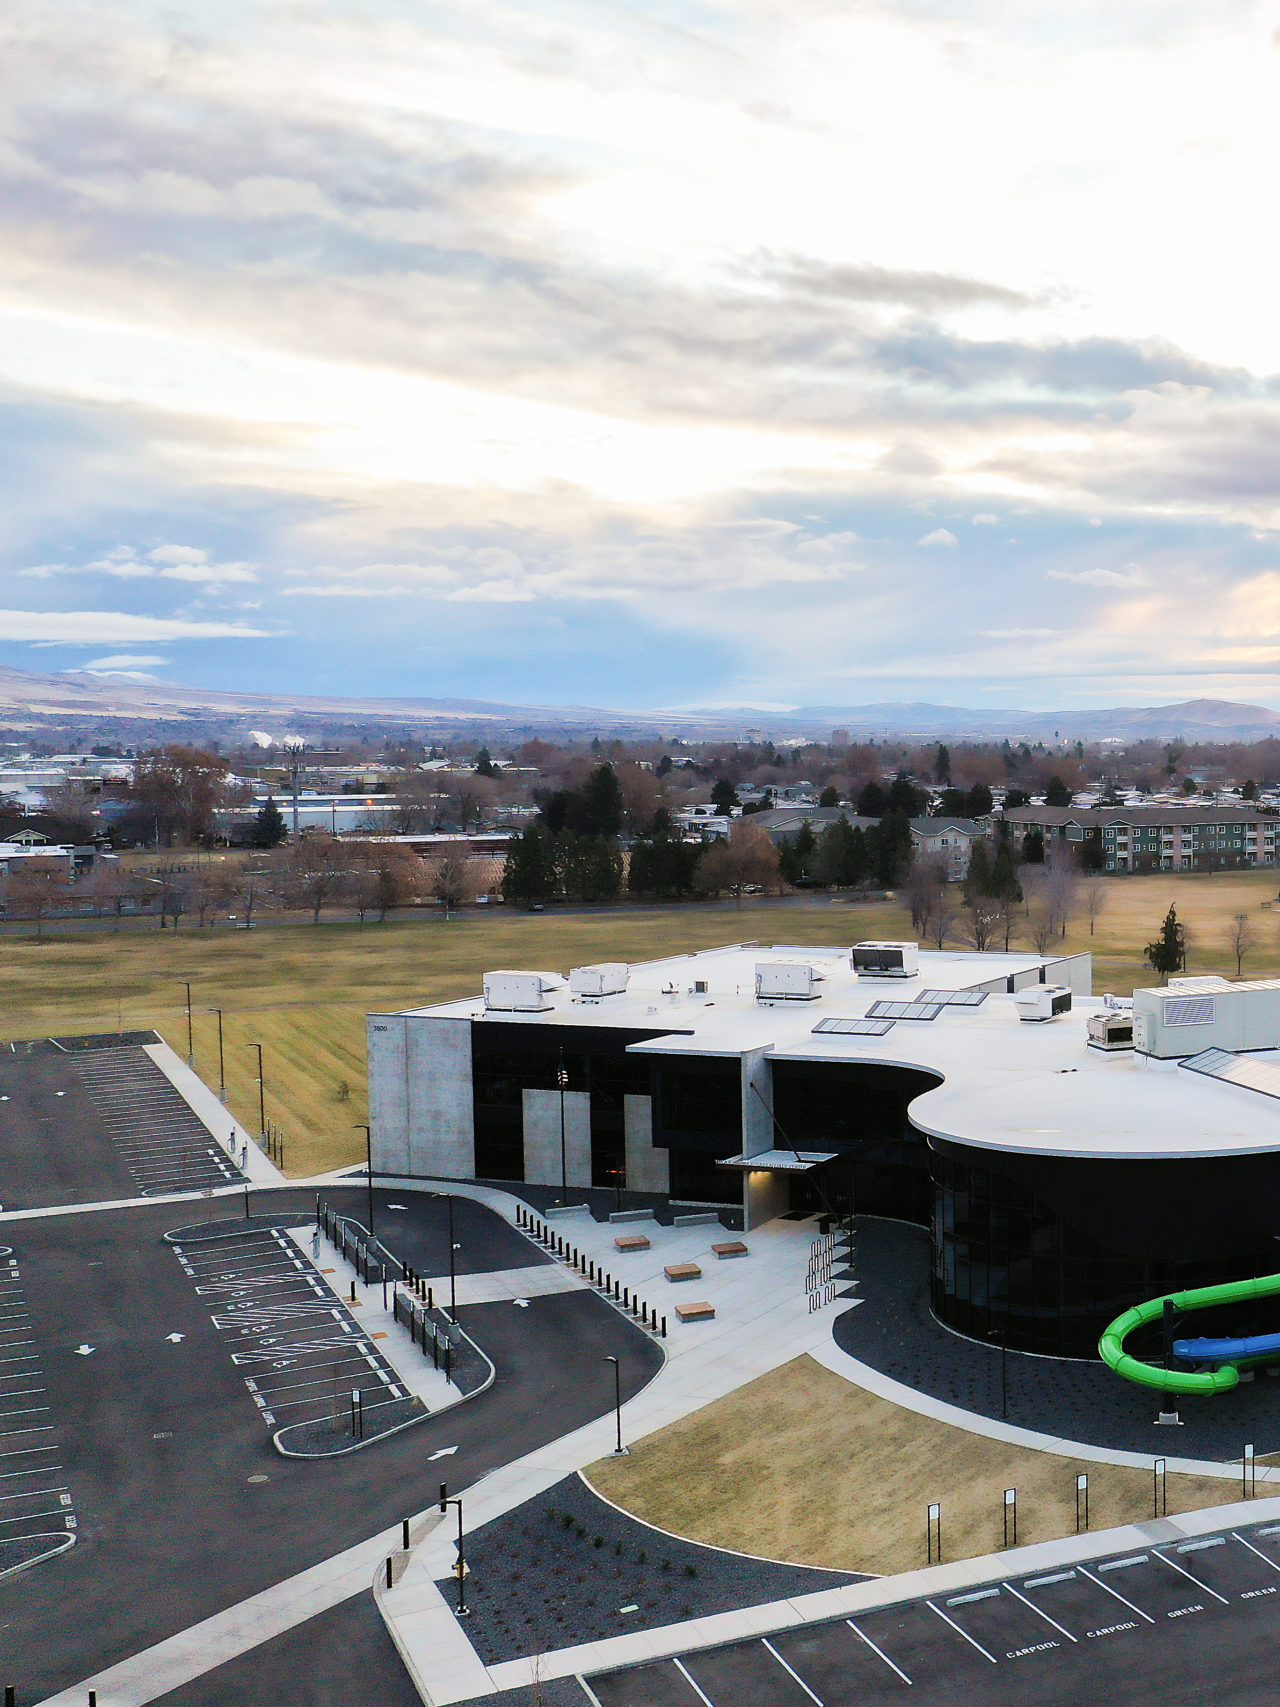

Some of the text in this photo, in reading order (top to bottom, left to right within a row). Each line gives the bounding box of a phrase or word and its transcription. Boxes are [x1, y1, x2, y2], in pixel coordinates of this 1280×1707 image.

[1240, 1586, 1278, 1599] GREEN
[1167, 1604, 1205, 1618] GREEN
[1086, 1621, 1140, 1638] CARPOOL
[1005, 1640, 1061, 1659] CARPOOL
